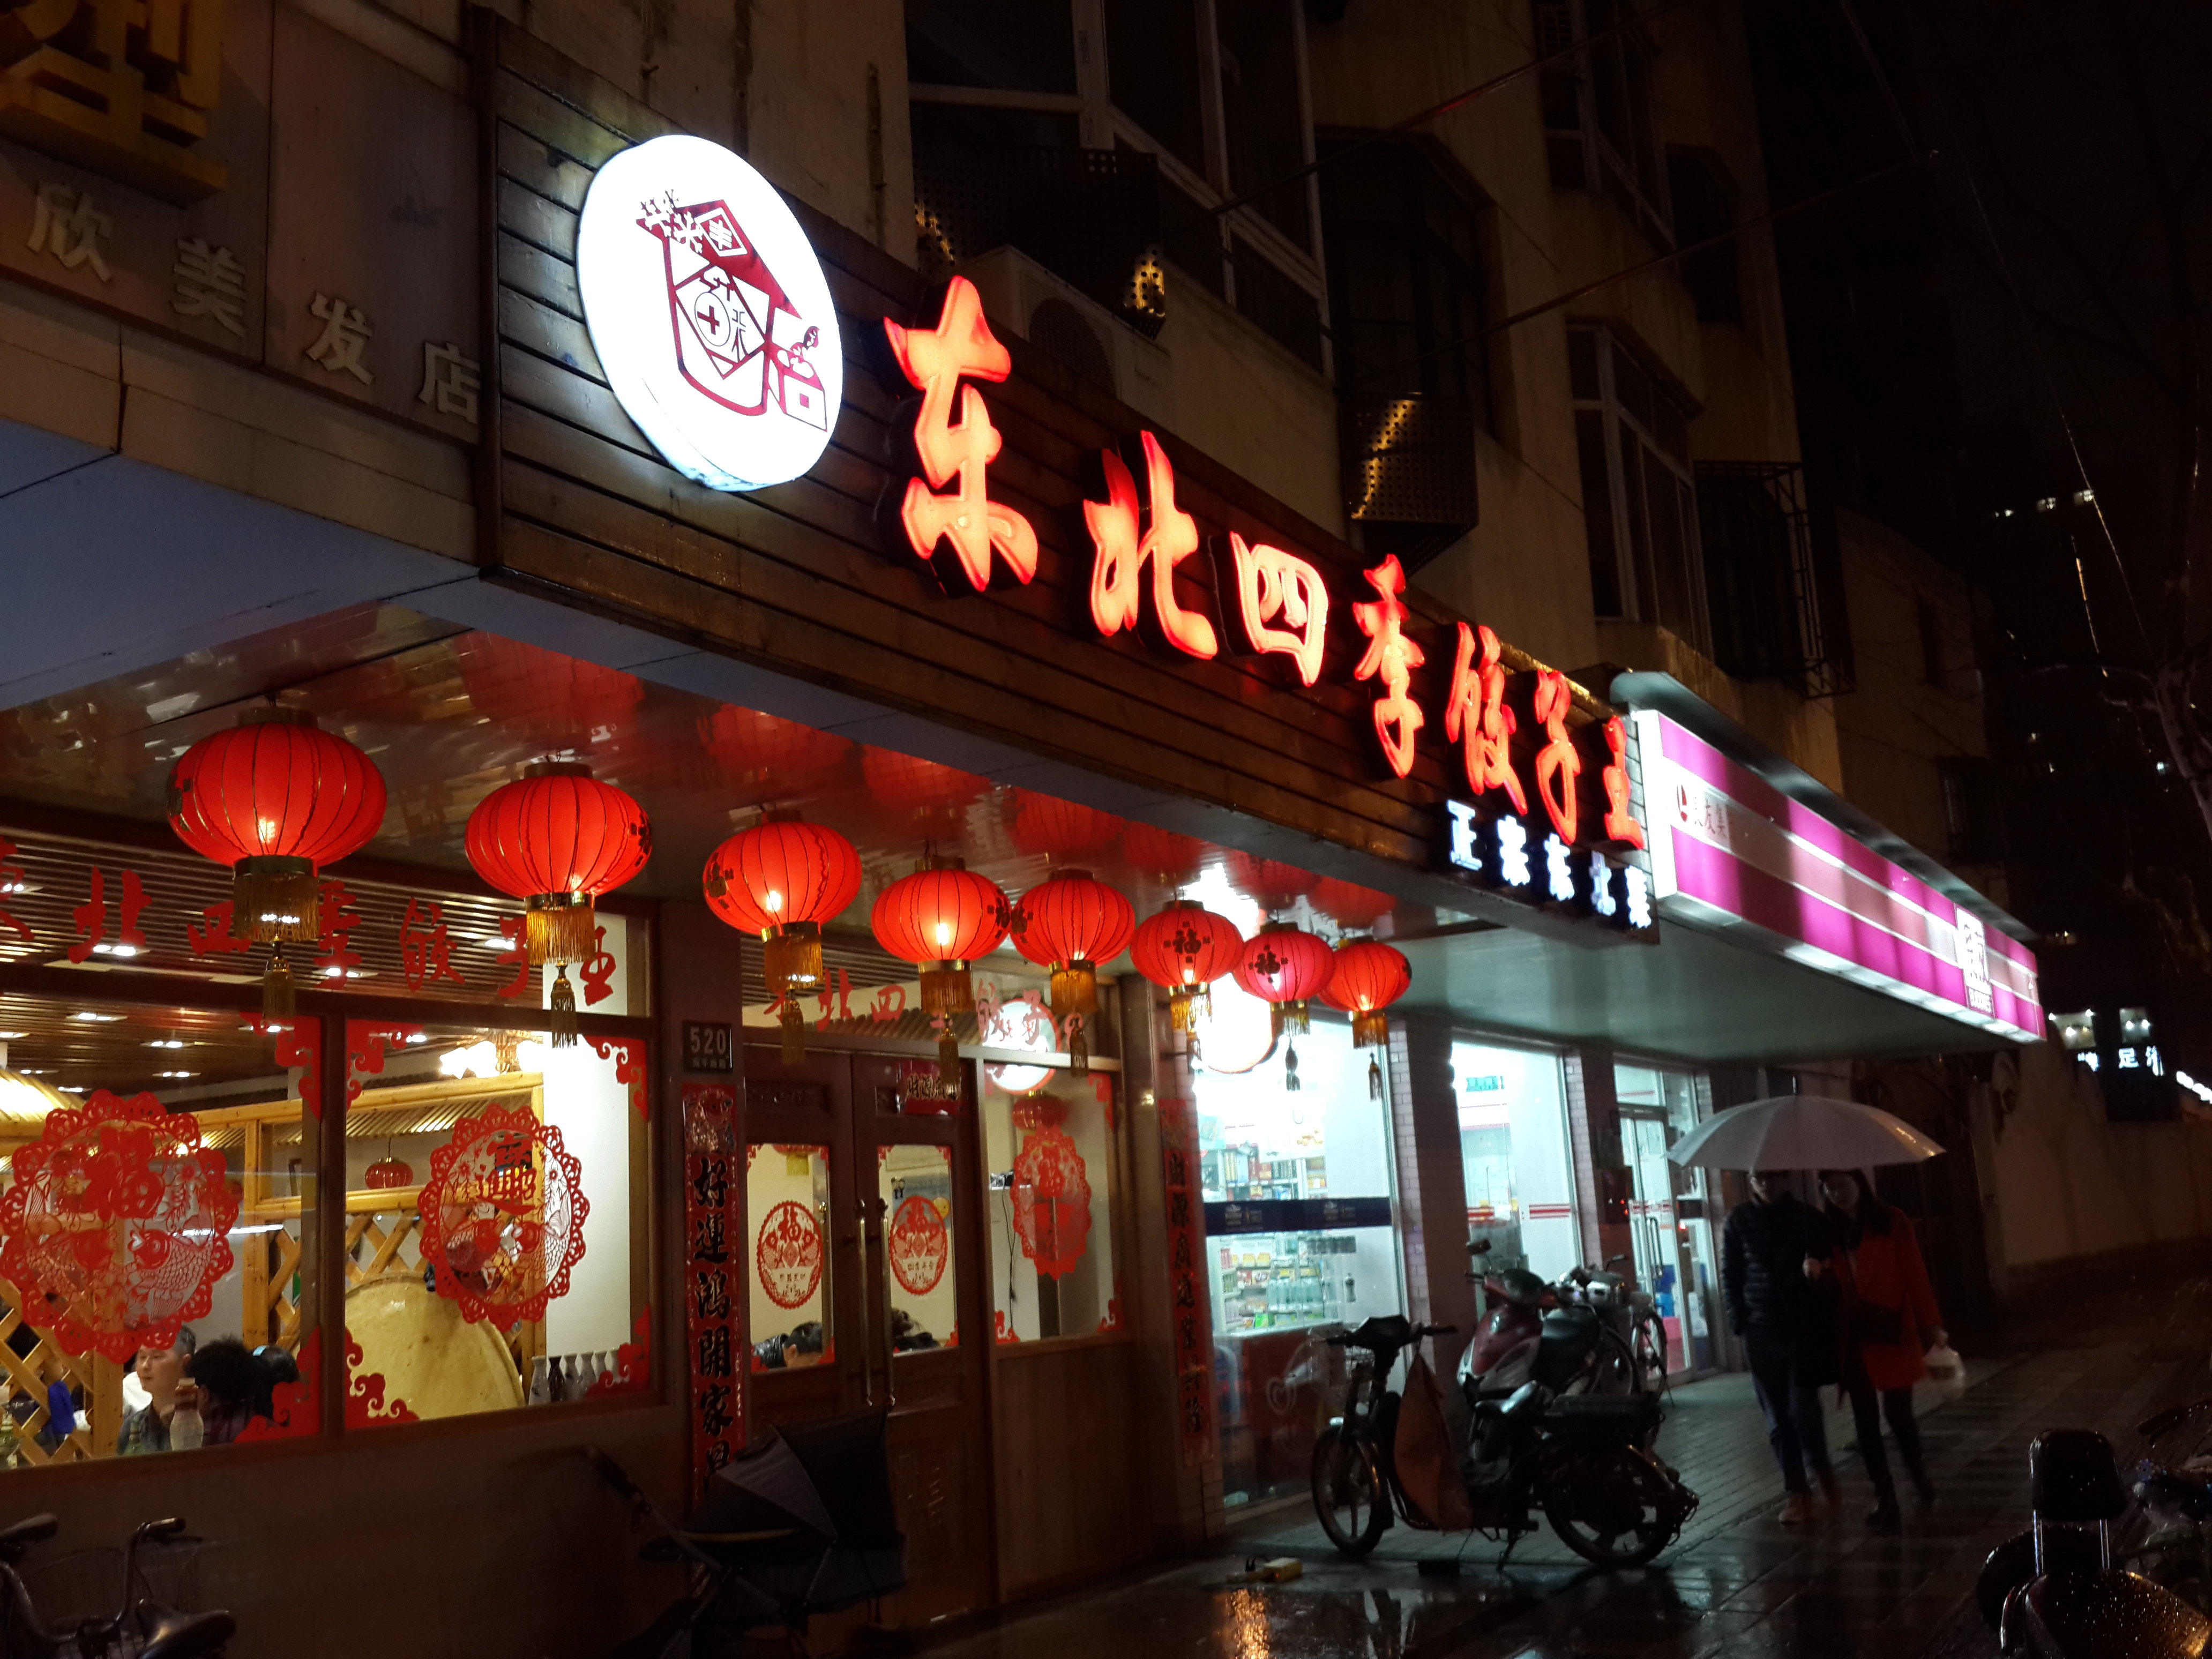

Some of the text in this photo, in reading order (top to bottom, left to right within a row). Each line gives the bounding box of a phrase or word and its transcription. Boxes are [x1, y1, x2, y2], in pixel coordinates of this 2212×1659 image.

[1172, 928, 1201, 954] 福
[1254, 951, 1281, 975] 福
[690, 1026, 727, 1056] 520
[778, 1206, 802, 1243] 福
